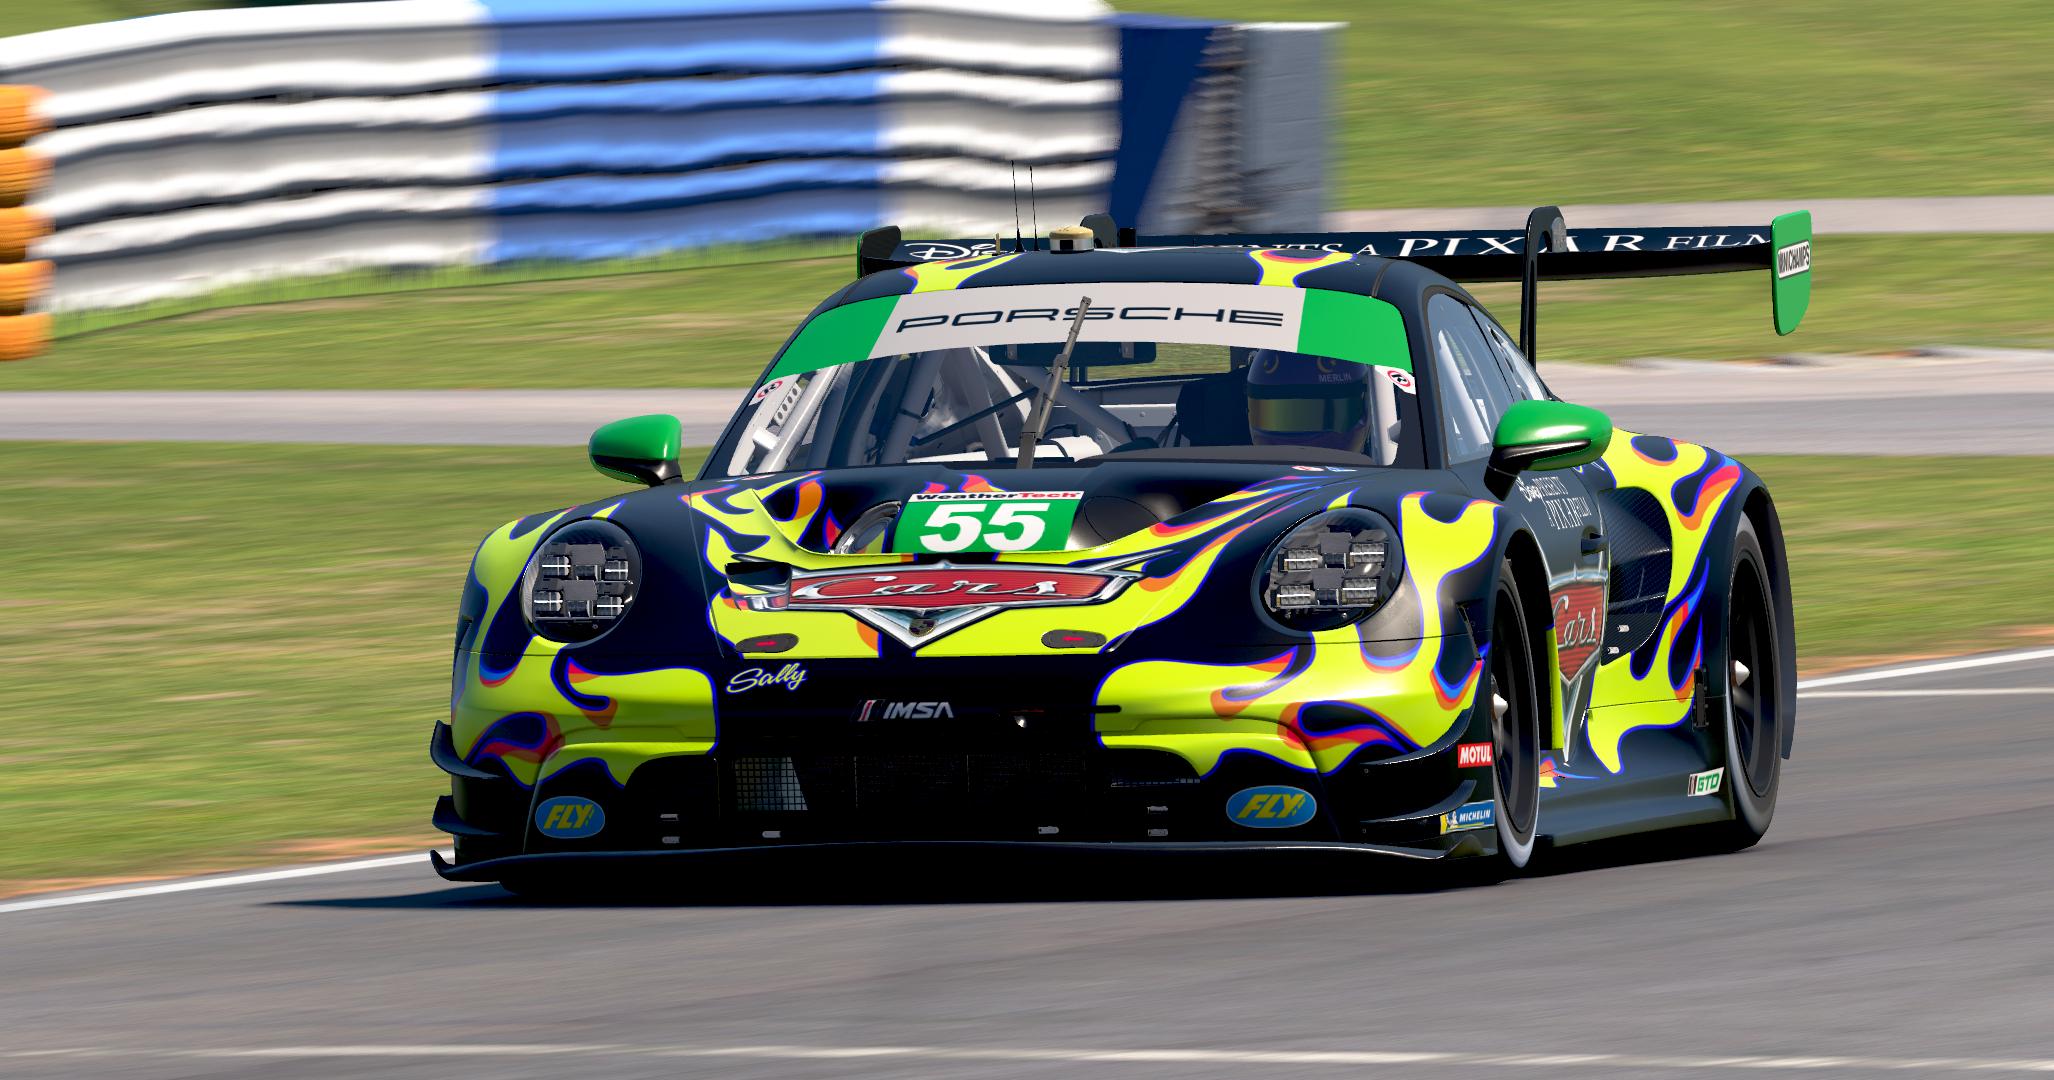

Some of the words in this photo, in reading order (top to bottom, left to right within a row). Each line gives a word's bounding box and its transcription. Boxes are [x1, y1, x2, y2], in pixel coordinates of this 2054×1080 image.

[896, 307, 1284, 333] PORSCHE
[1318, 373, 1352, 383] MERLIN
[916, 492, 1079, 501] WeatherTech
[919, 503, 1050, 552] 55
[792, 575, 1067, 599] Cars
[1554, 595, 1597, 649] Cars
[726, 662, 806, 693] Sally
[882, 701, 954, 720] IMSA
[1459, 745, 1492, 765] MOTUL
[1697, 772, 1720, 792] GTD
[1459, 809, 1491, 823] MICHELIN
